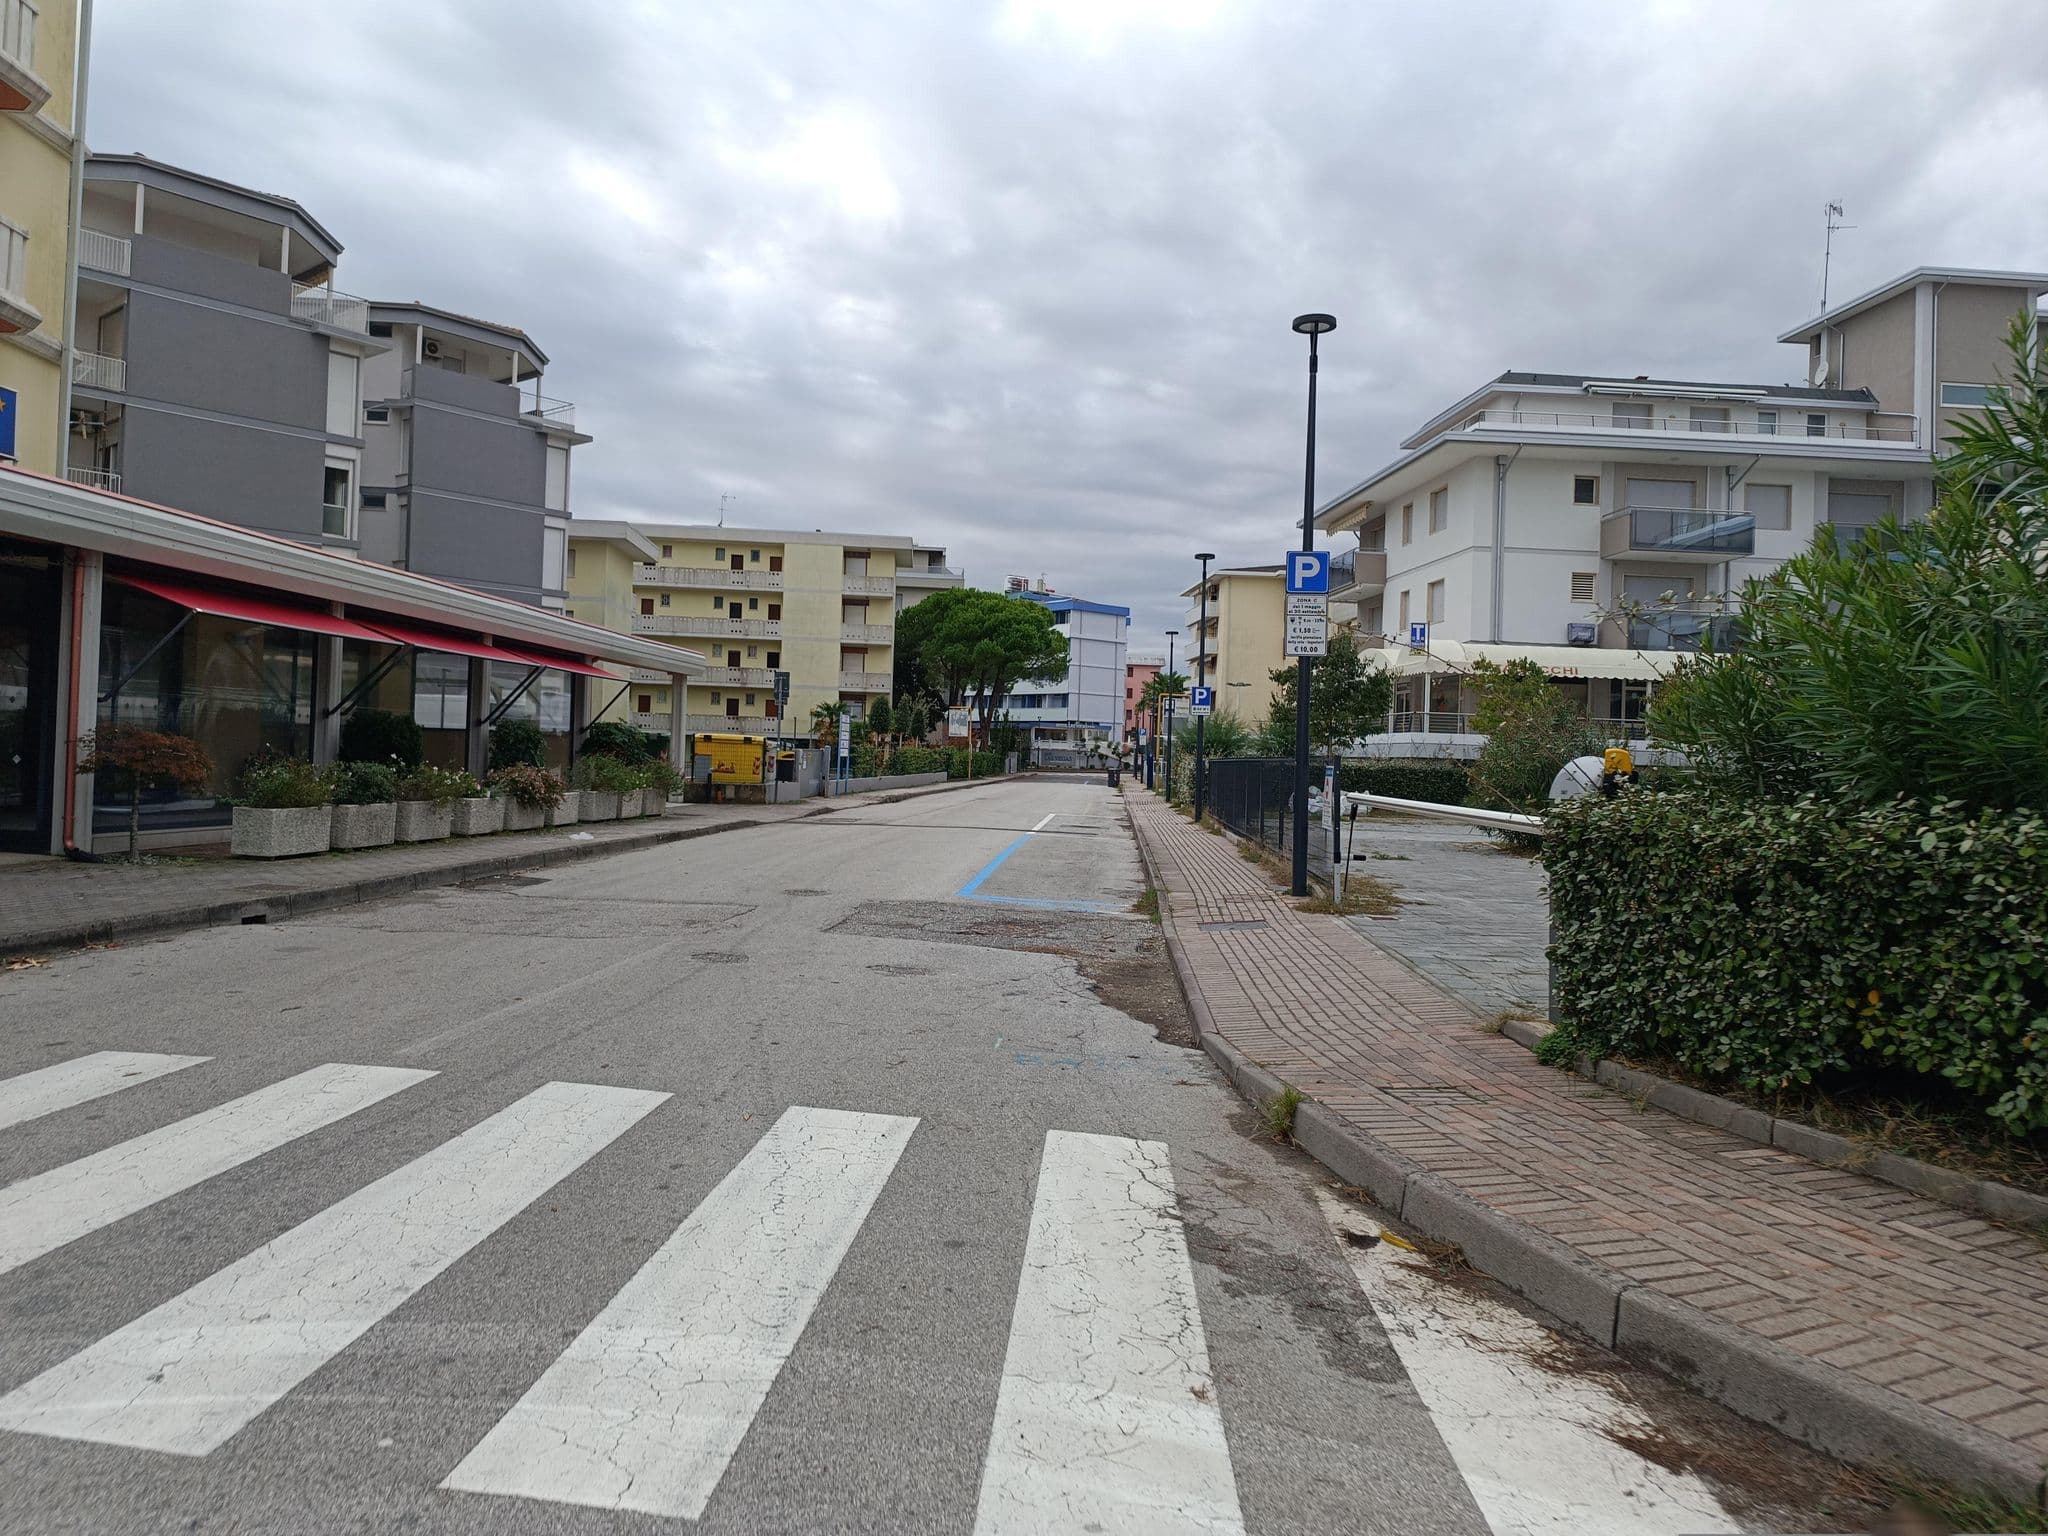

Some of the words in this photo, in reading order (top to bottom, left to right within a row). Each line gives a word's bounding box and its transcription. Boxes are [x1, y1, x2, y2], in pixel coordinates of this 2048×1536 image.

[1295, 556, 1320, 588] P
[1412, 624, 1425, 641] T
[1195, 689, 1207, 704] P
